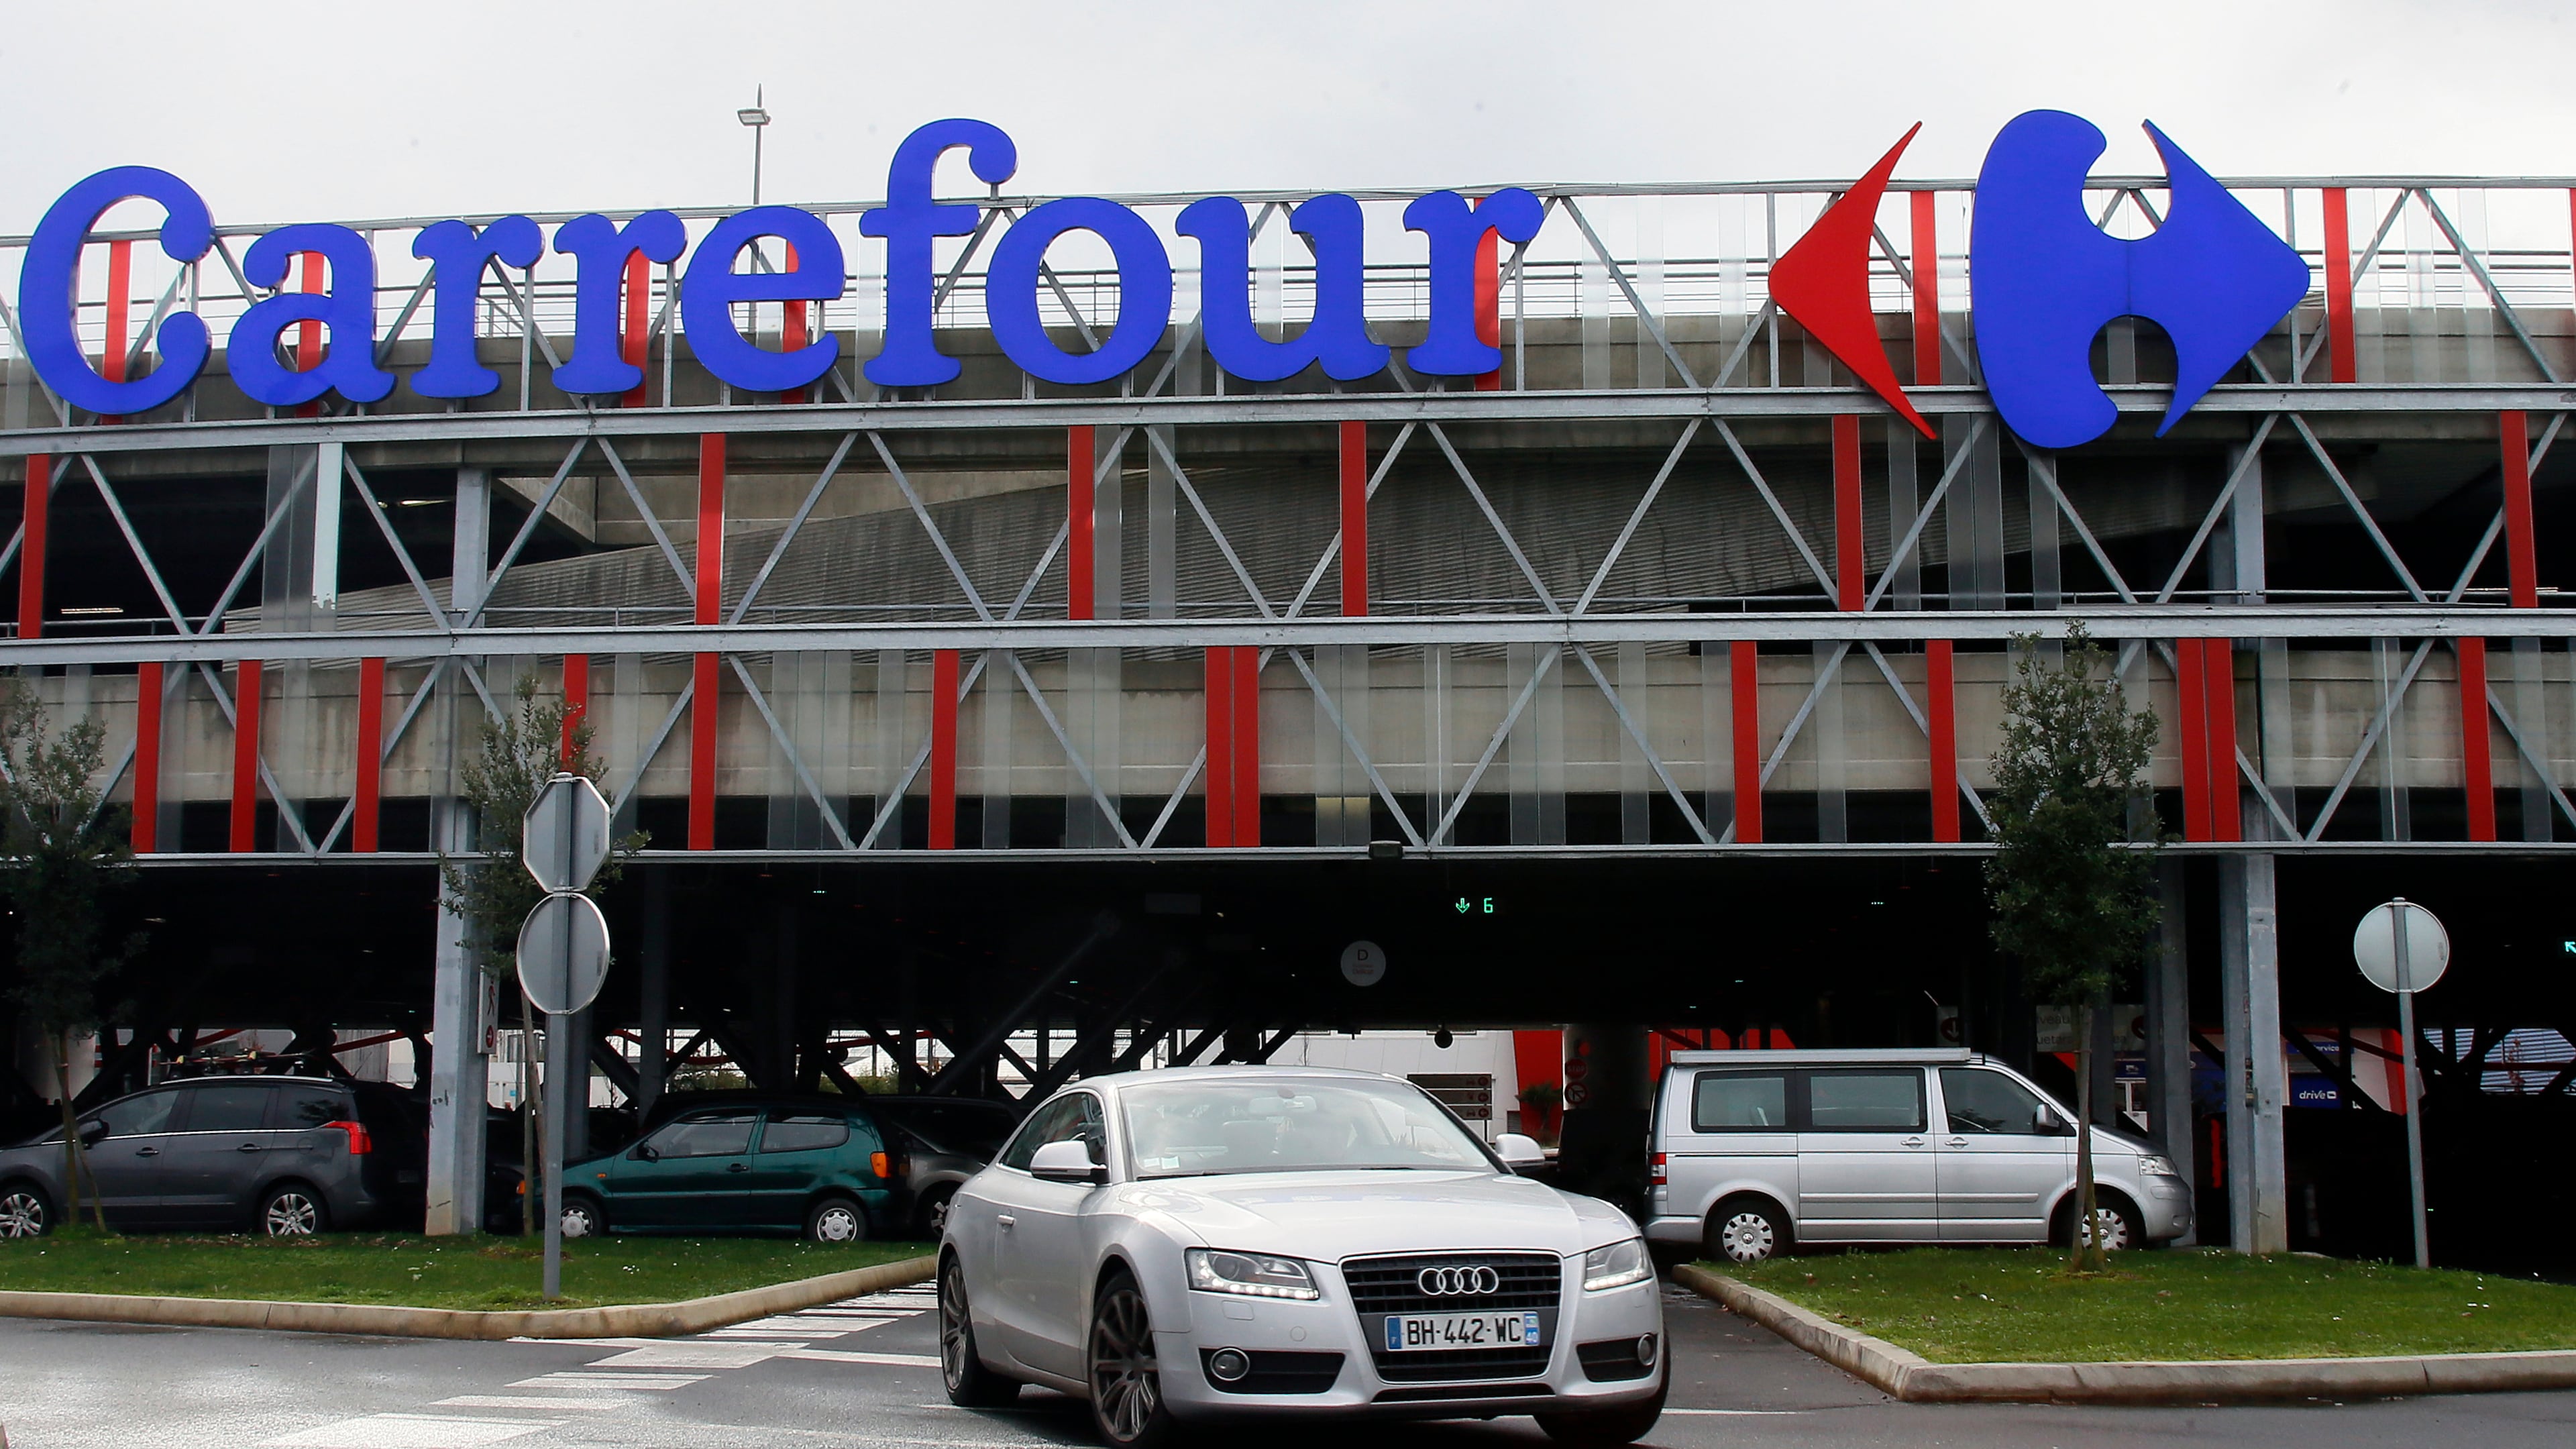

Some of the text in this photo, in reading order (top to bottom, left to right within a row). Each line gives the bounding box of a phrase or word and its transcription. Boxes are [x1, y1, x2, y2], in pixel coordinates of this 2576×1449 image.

[19, 117, 1544, 415] Carrefour
[1483, 898, 1493, 914] 6
[1357, 949, 1368, 961] D
[2299, 1089, 2326, 1099] drive
[1407, 1317, 1520, 1346] BH-442-WC
